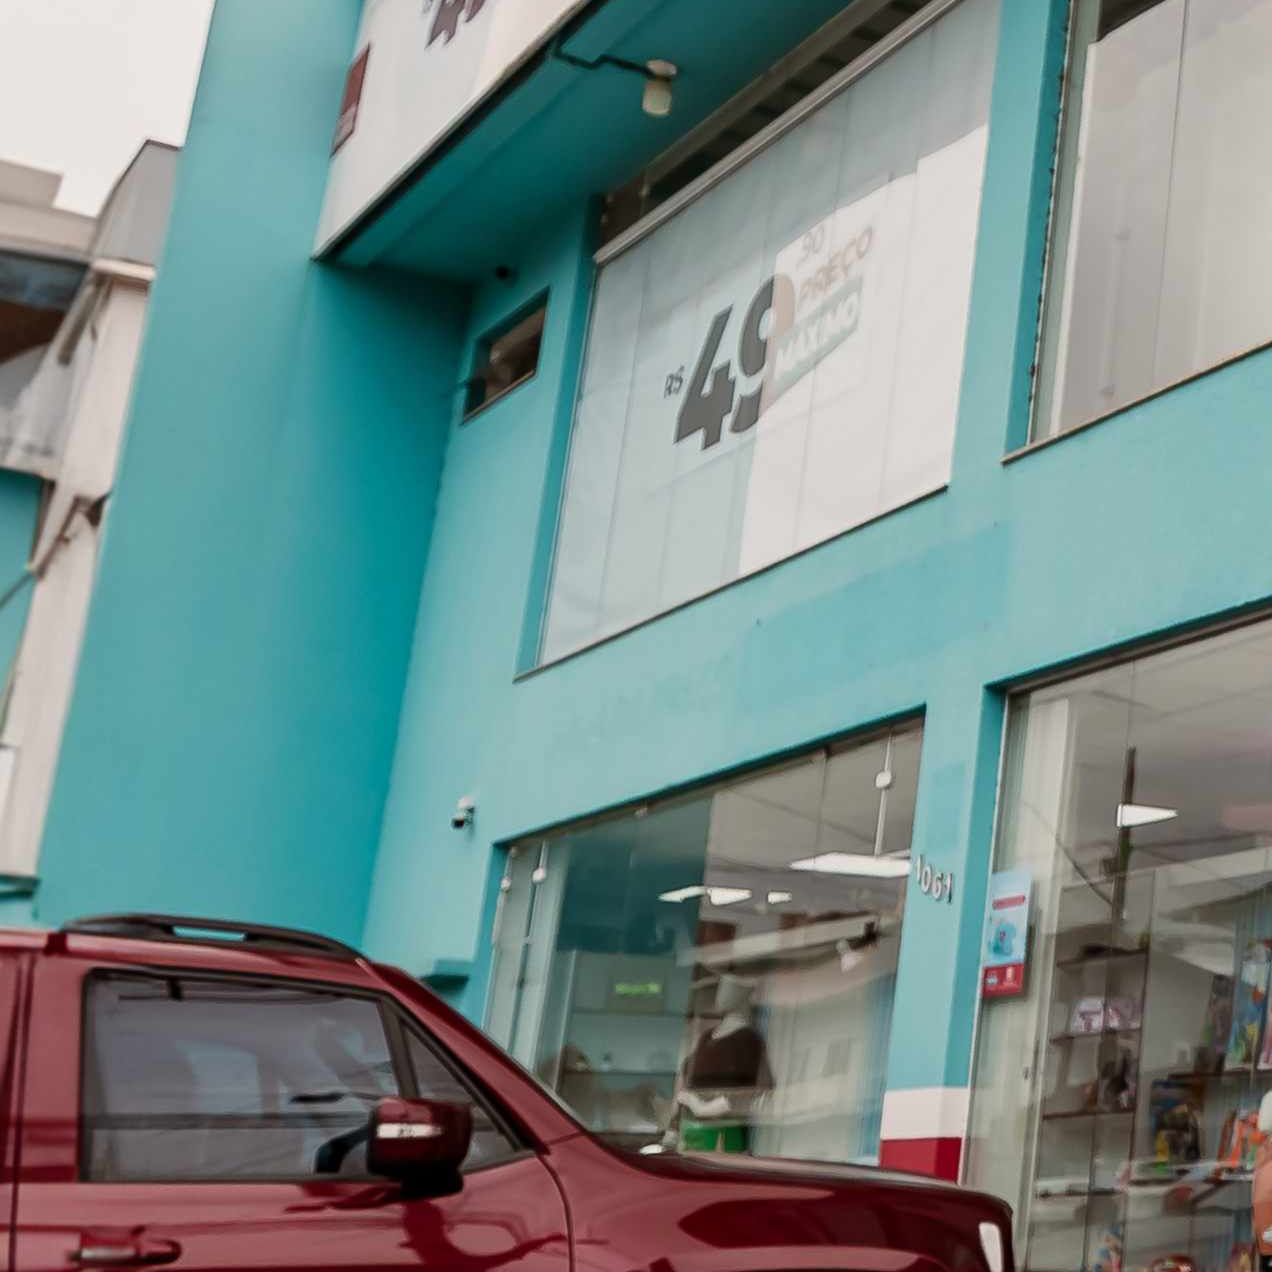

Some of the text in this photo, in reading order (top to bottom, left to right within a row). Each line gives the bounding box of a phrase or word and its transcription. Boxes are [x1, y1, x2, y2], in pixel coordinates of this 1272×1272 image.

[663, 363, 686, 400] R$
[672, 274, 797, 453] 49
[915, 854, 954, 905] 1061
